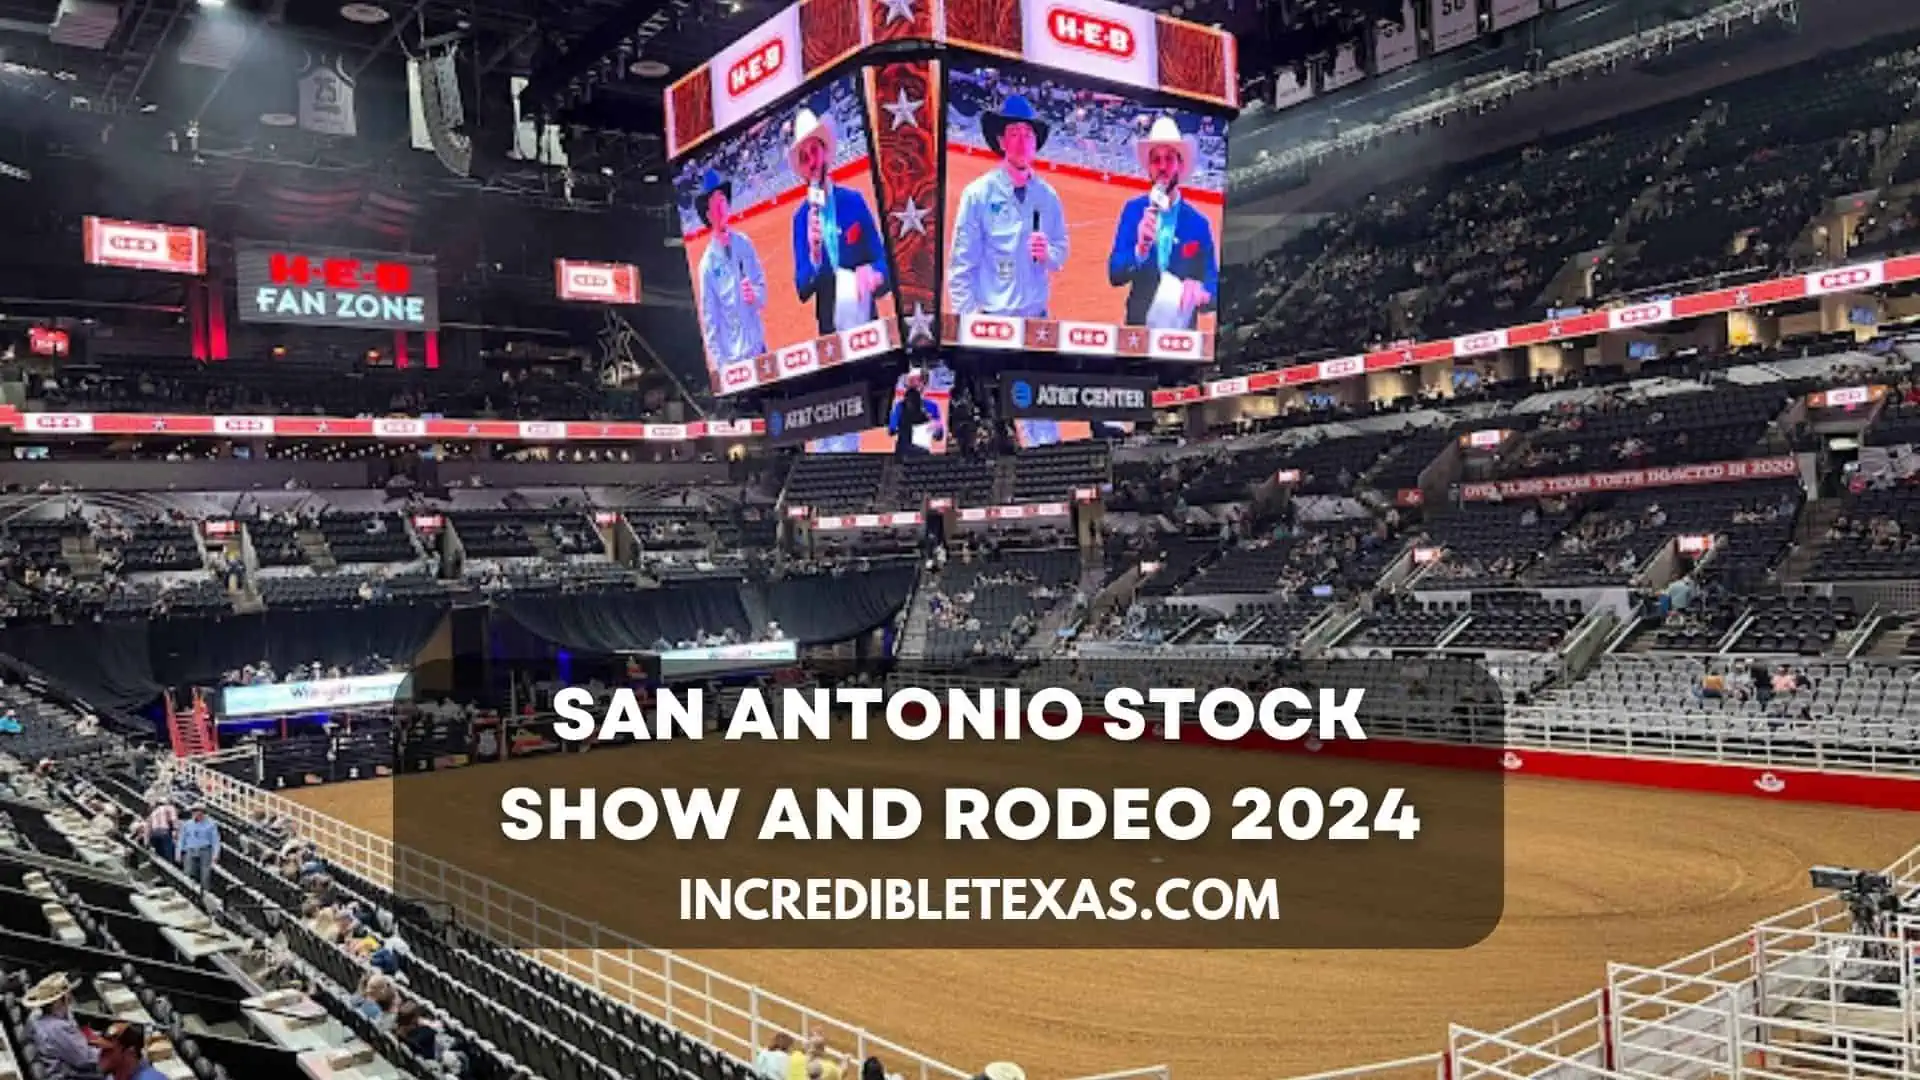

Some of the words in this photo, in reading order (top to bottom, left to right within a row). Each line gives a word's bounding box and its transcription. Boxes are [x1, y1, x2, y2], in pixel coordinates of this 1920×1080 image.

[256, 287, 326, 315] FAN
[335, 292, 425, 322] ZONE
[814, 396, 864, 424] CENTER
[1036, 385, 1079, 406] AT&T
[1081, 388, 1145, 409] CENTER
[1728, 463, 1746, 476] IN
[1752, 458, 1796, 474] 2020
